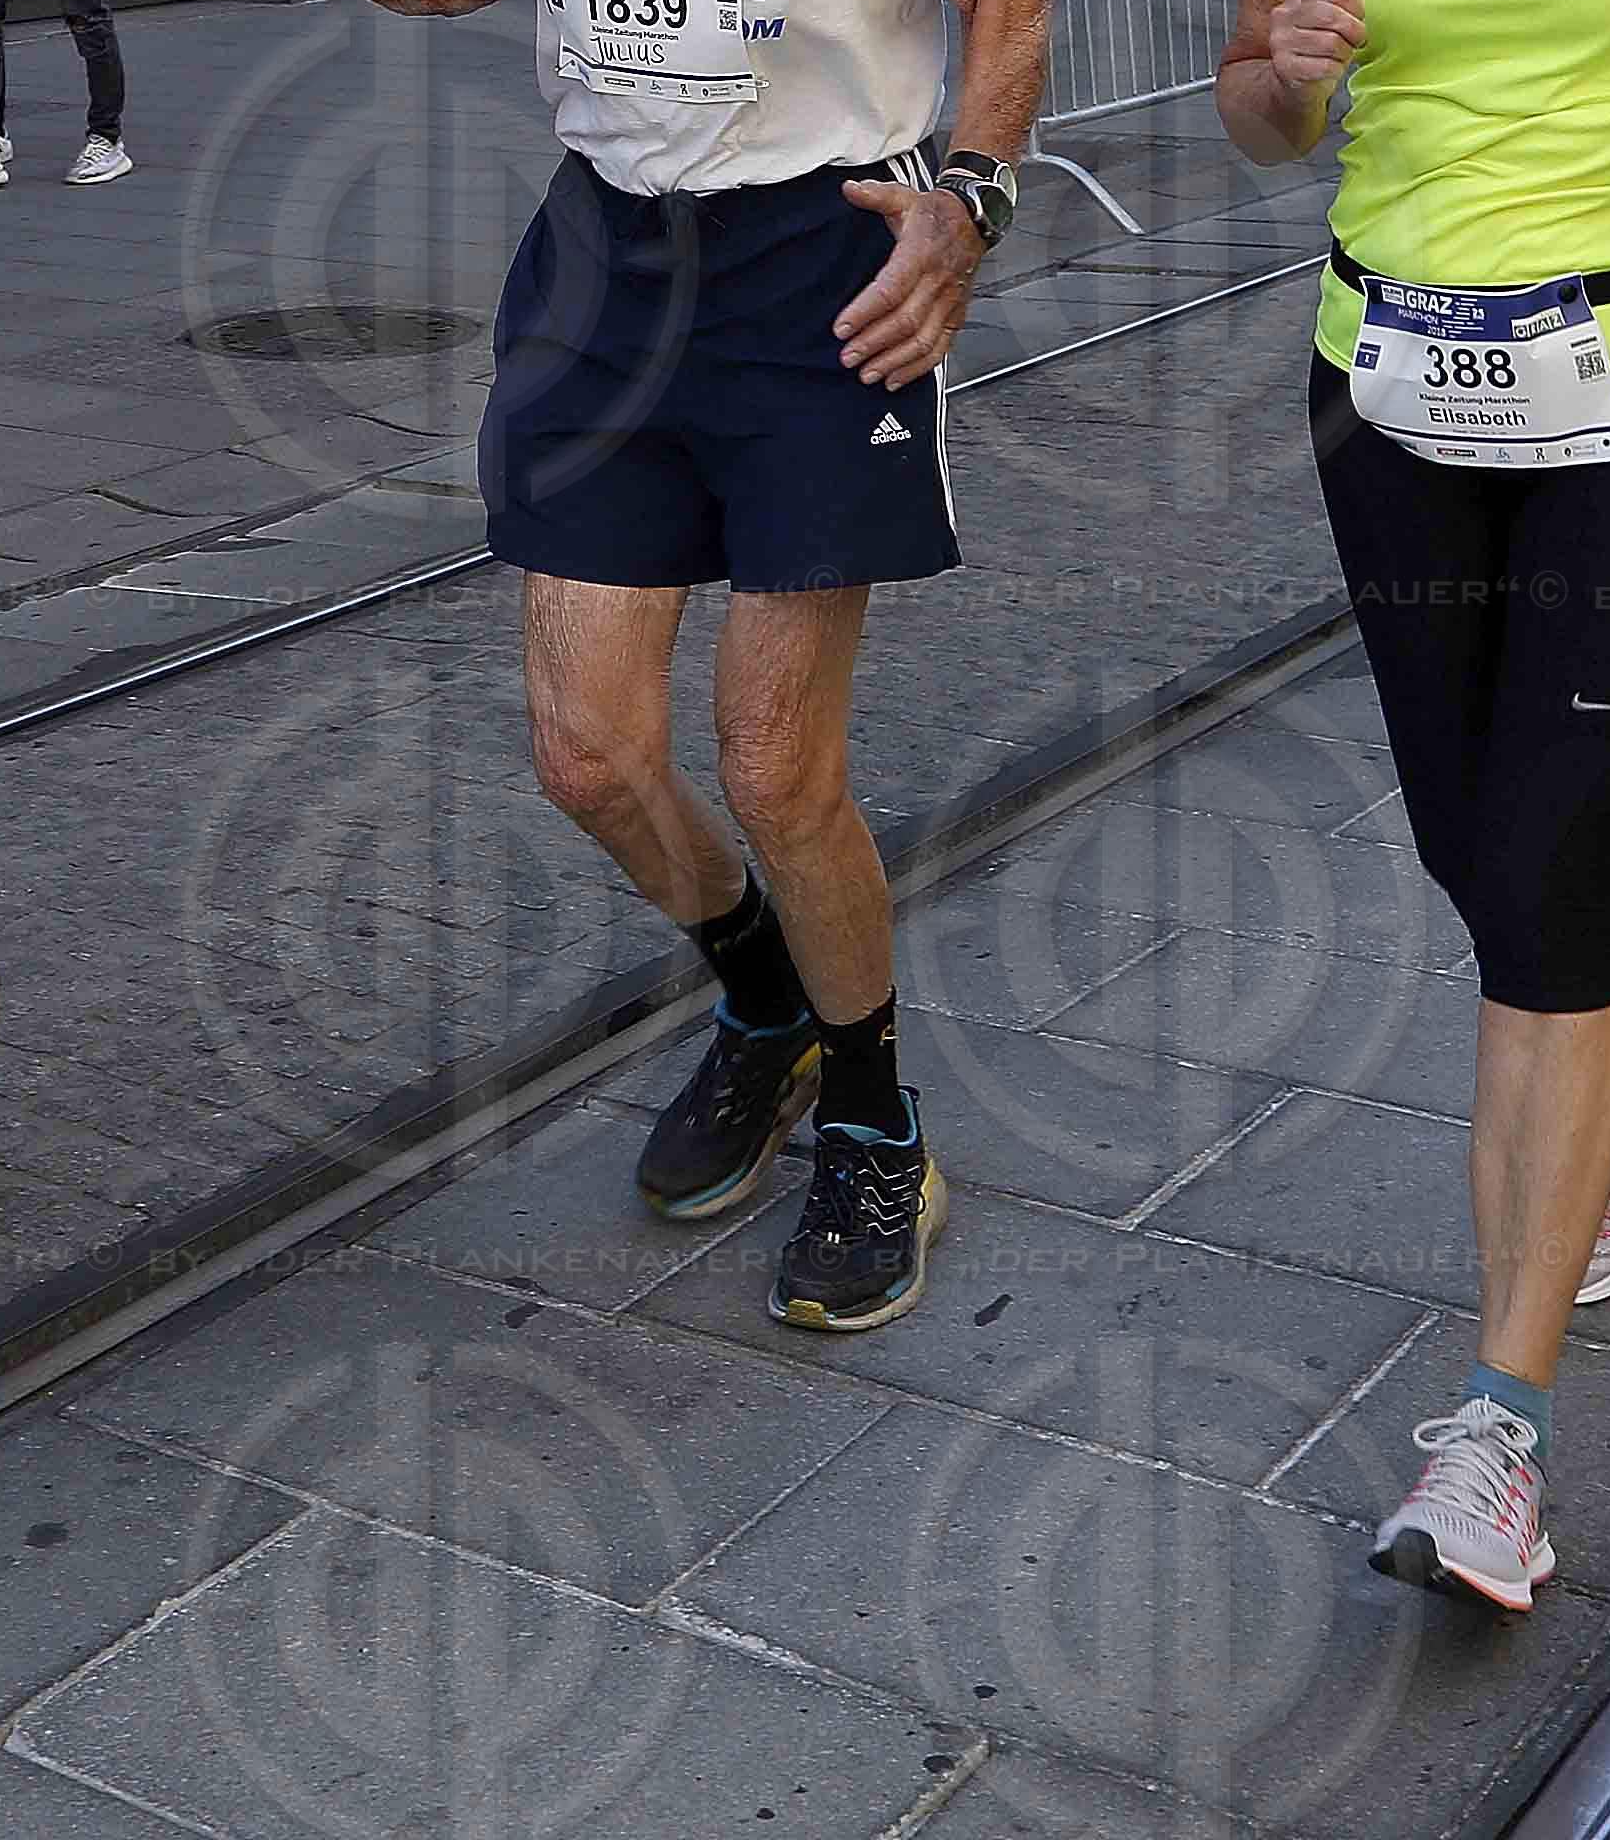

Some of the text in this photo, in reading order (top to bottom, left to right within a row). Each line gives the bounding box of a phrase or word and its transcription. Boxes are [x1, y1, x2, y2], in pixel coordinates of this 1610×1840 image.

[644, 31, 679, 41] Marathon
[589, 36, 665, 66] JULIUS
[1406, 290, 1453, 315] GRAZ
[1398, 307, 1439, 325] MARATHON
[1424, 345, 1516, 388] 388
[1484, 396, 1530, 404] Marathon
[870, 429, 911, 445] adidas
